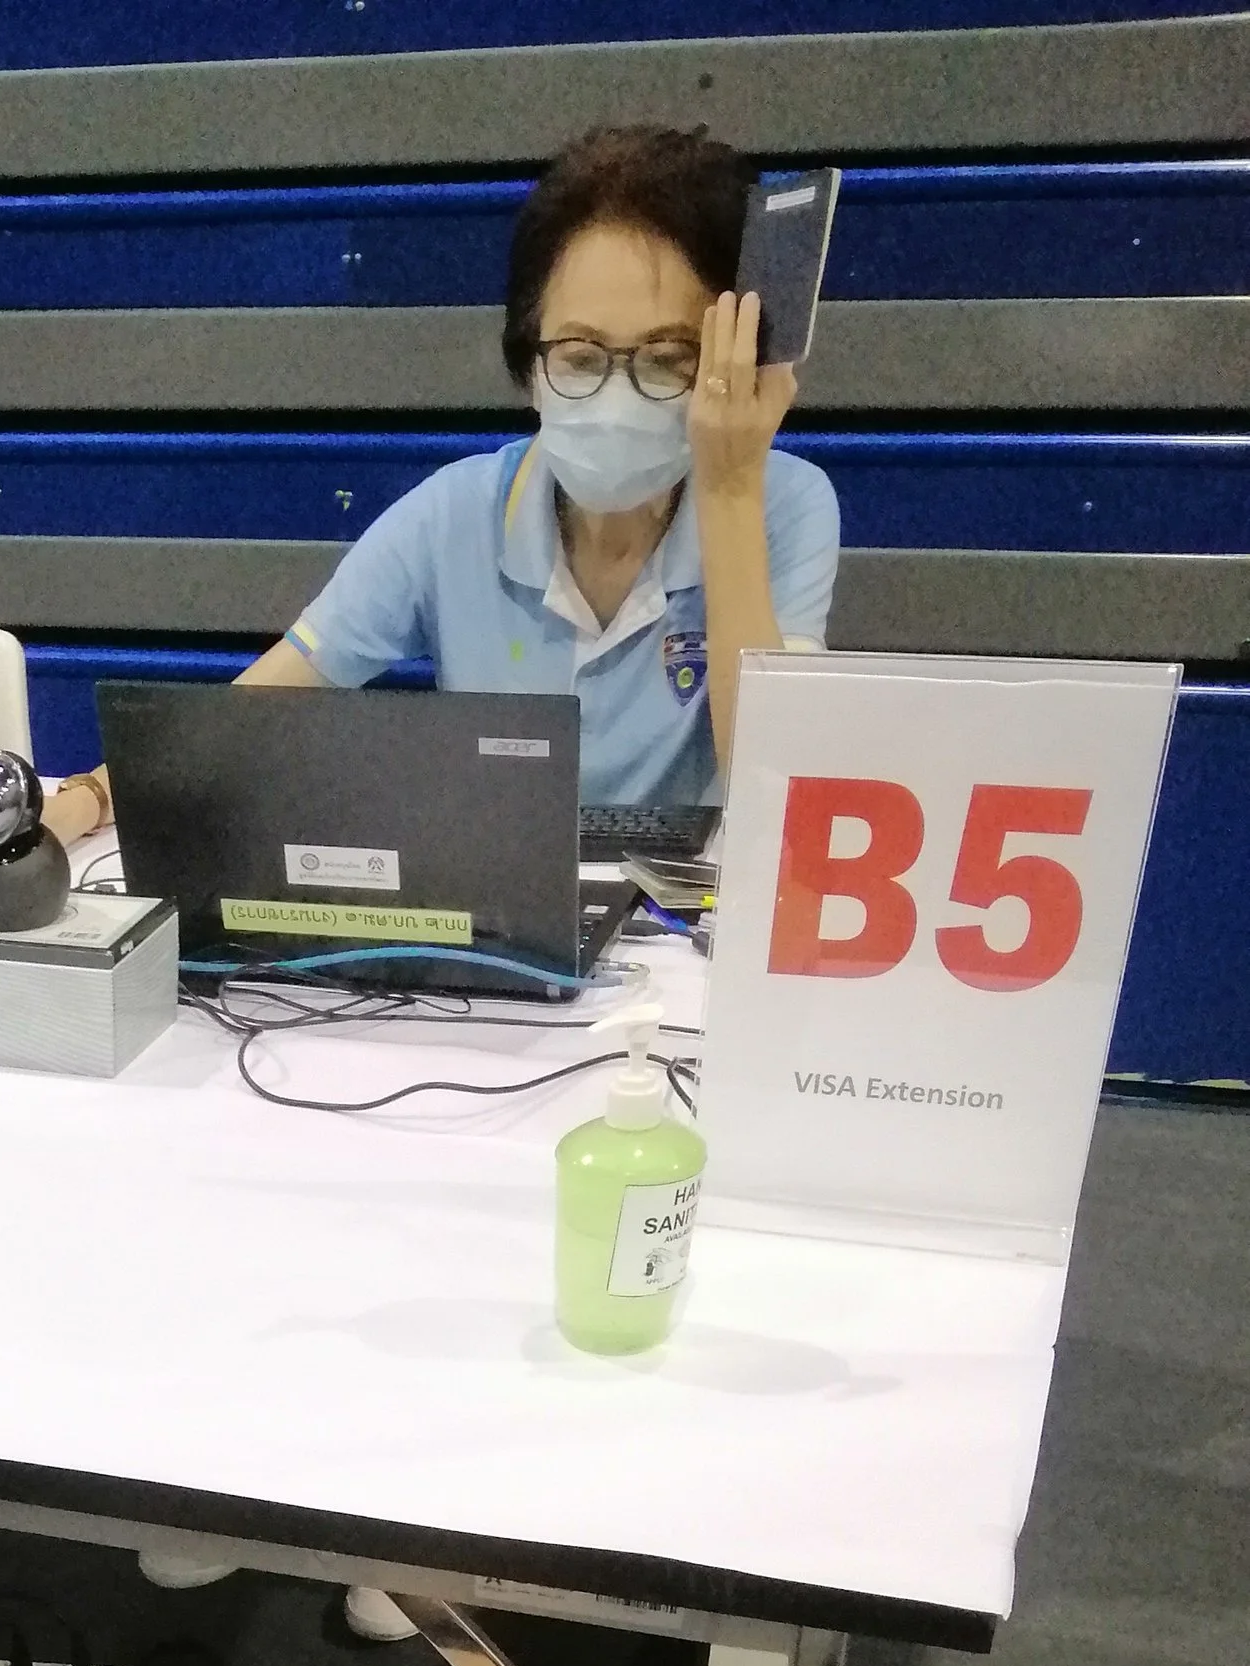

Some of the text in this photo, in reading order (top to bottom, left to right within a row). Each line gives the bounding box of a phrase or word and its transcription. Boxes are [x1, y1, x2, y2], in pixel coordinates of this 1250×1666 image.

[766, 775, 1095, 993] B5
[794, 1071, 1004, 1110] VISA Extension
